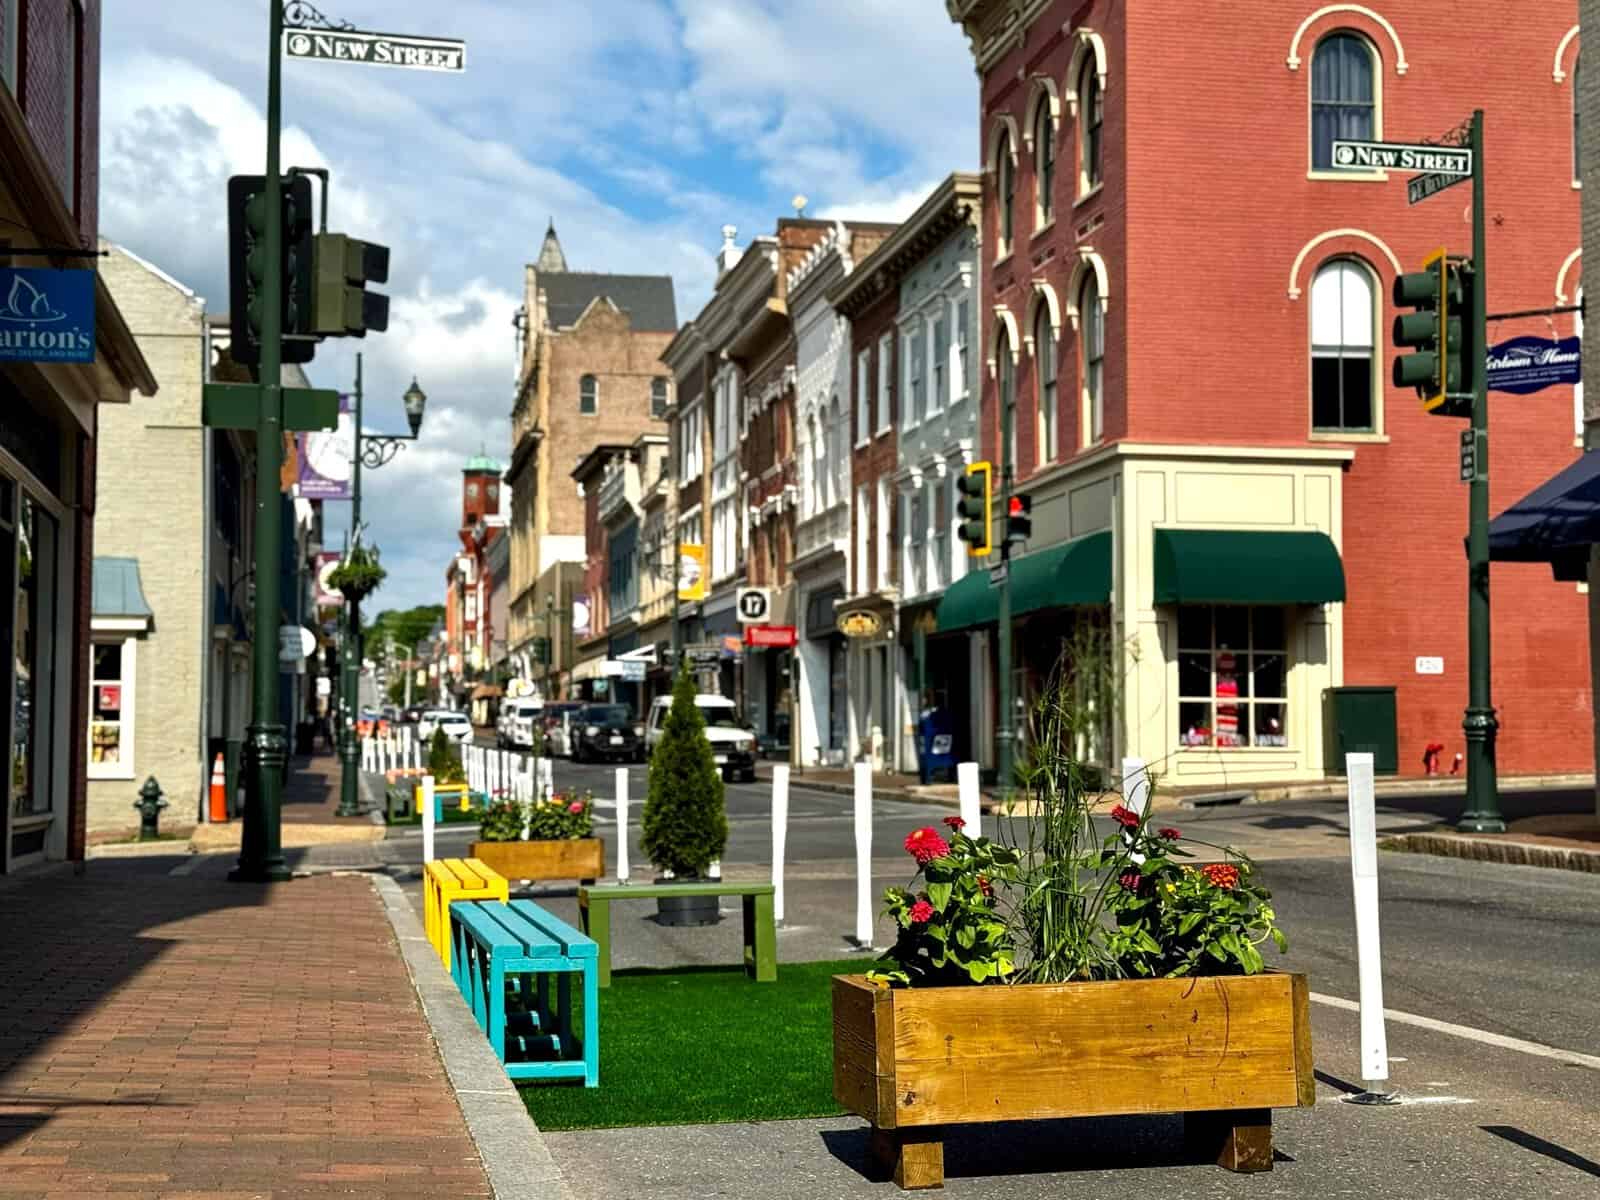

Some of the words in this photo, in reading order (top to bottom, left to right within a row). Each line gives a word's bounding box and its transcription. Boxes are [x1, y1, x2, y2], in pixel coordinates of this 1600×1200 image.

[314, 35, 369, 60] NEW
[373, 40, 461, 69] STREET
[1356, 147, 1398, 167] NEW
[1401, 149, 1467, 171] STREET
[0, 322, 90, 349] arion's
[1486, 353, 1531, 370] eirloom
[745, 596, 762, 614] 17
